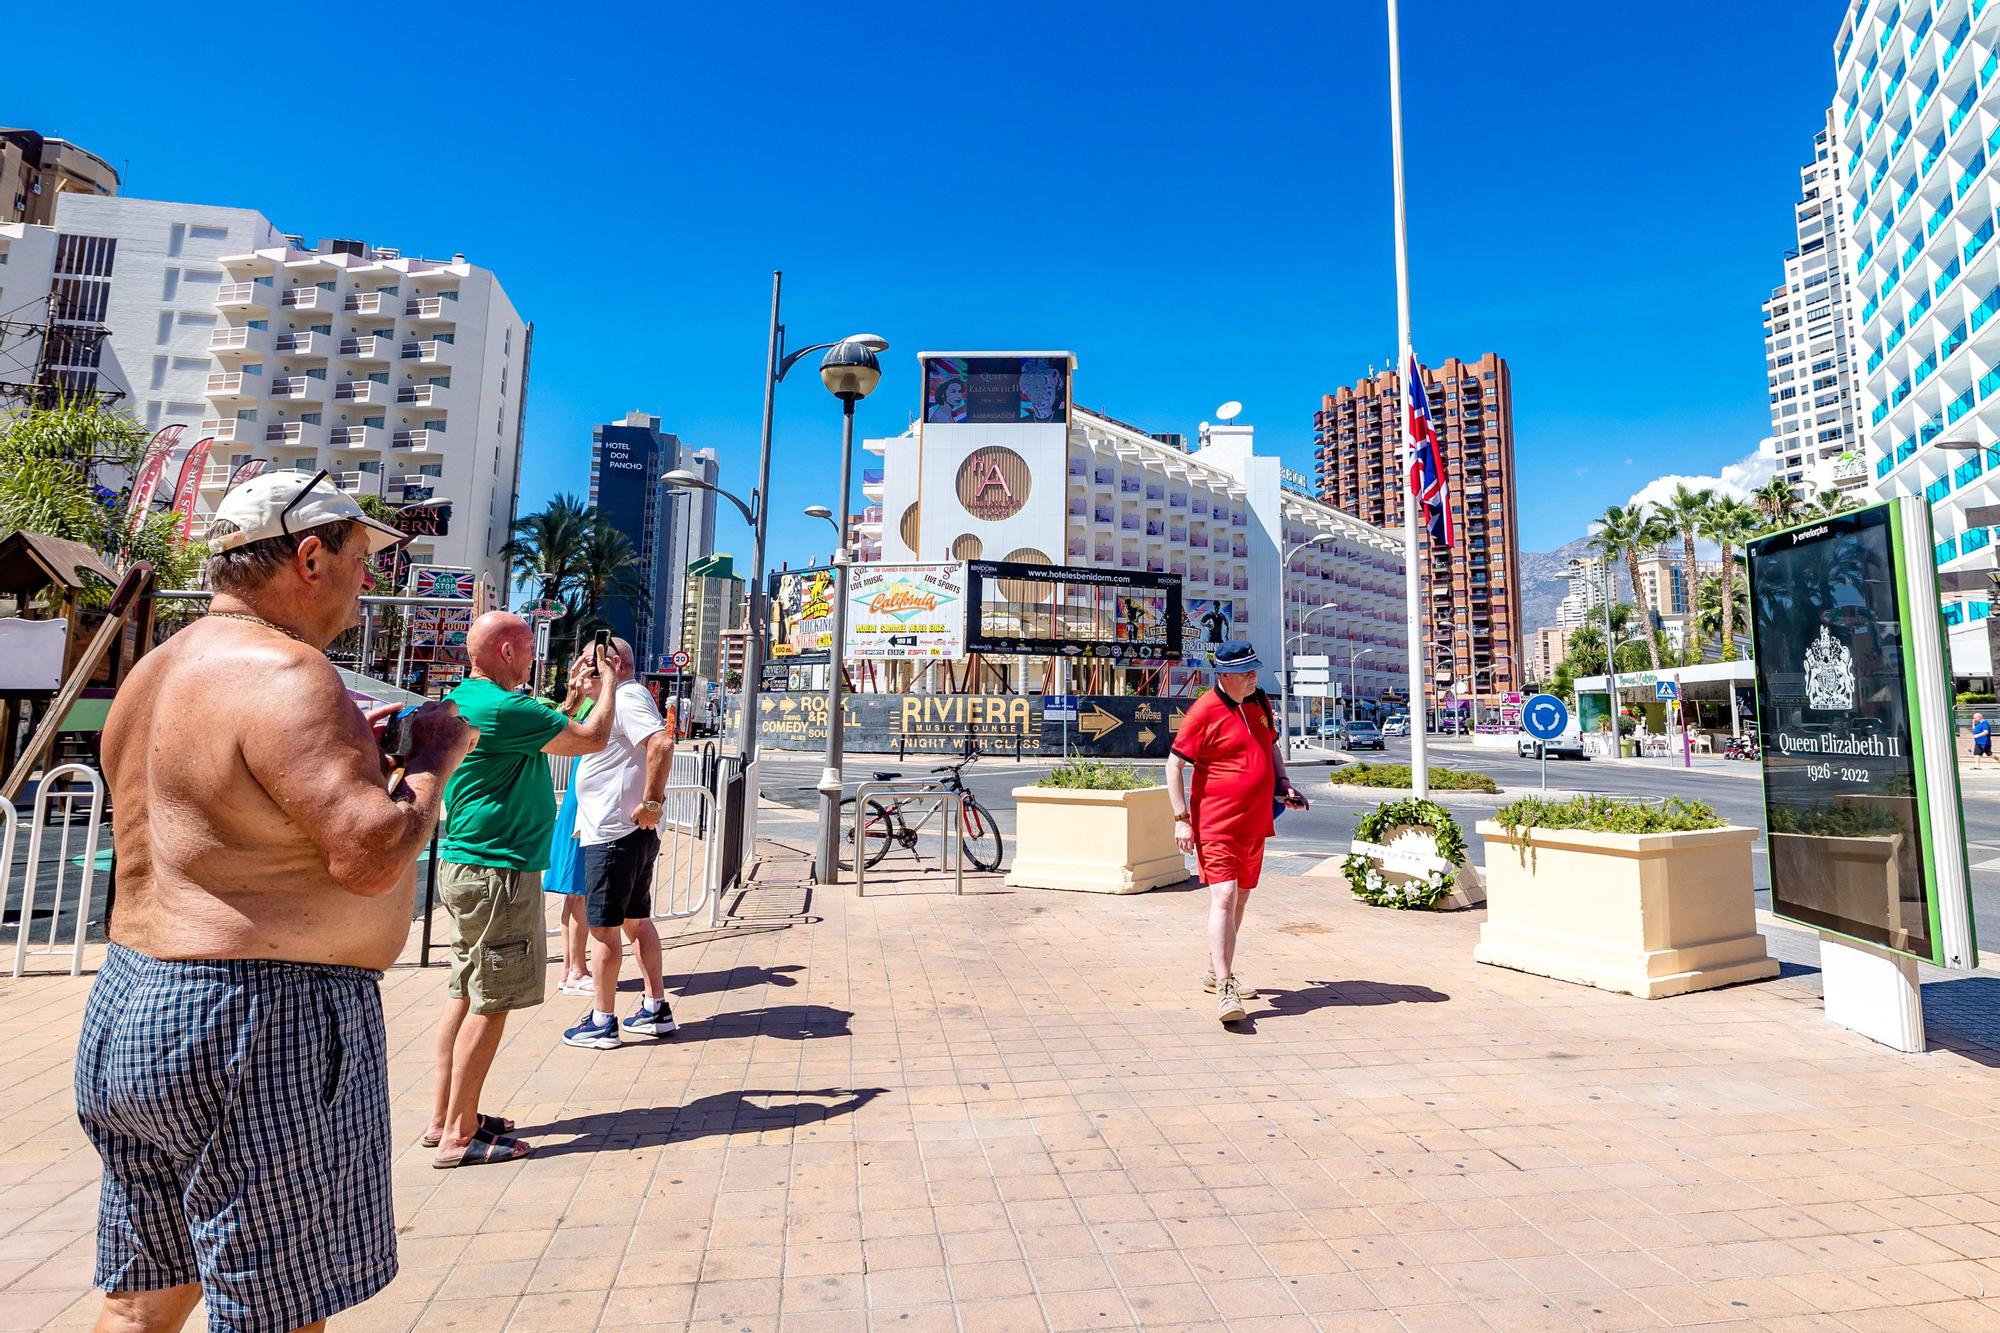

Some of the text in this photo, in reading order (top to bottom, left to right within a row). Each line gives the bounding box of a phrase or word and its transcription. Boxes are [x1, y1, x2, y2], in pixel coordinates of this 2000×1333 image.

[605, 442, 630, 450] HOTEL
[610, 461, 643, 470] PANCHO
[976, 458, 1012, 497] A
[970, 564, 998, 573] BENIDORM
[1028, 569, 1131, 583] www.hotelesbenidorm.com
[850, 574, 884, 591] LIVE MUSIC
[924, 574, 961, 594] LIVE SPORTS
[869, 591, 938, 614] California
[416, 621, 467, 631] FAST FOOD
[799, 618, 833, 634] ROCKING
[1197, 642, 1219, 651] DRIN
[808, 711, 861, 727] & RLL
[902, 696, 1030, 734] RIVIERA
[762, 721, 809, 733] COMEDY
[915, 724, 1016, 732] MUSIC LOUNGE
[890, 739, 899, 748] A
[904, 738, 947, 748] NIGHT
[953, 738, 988, 749] WTH
[1779, 732, 1900, 757] Queen Elizabeth II
[1807, 762, 1831, 781] 1926
[1841, 768, 1870, 783] 2022
